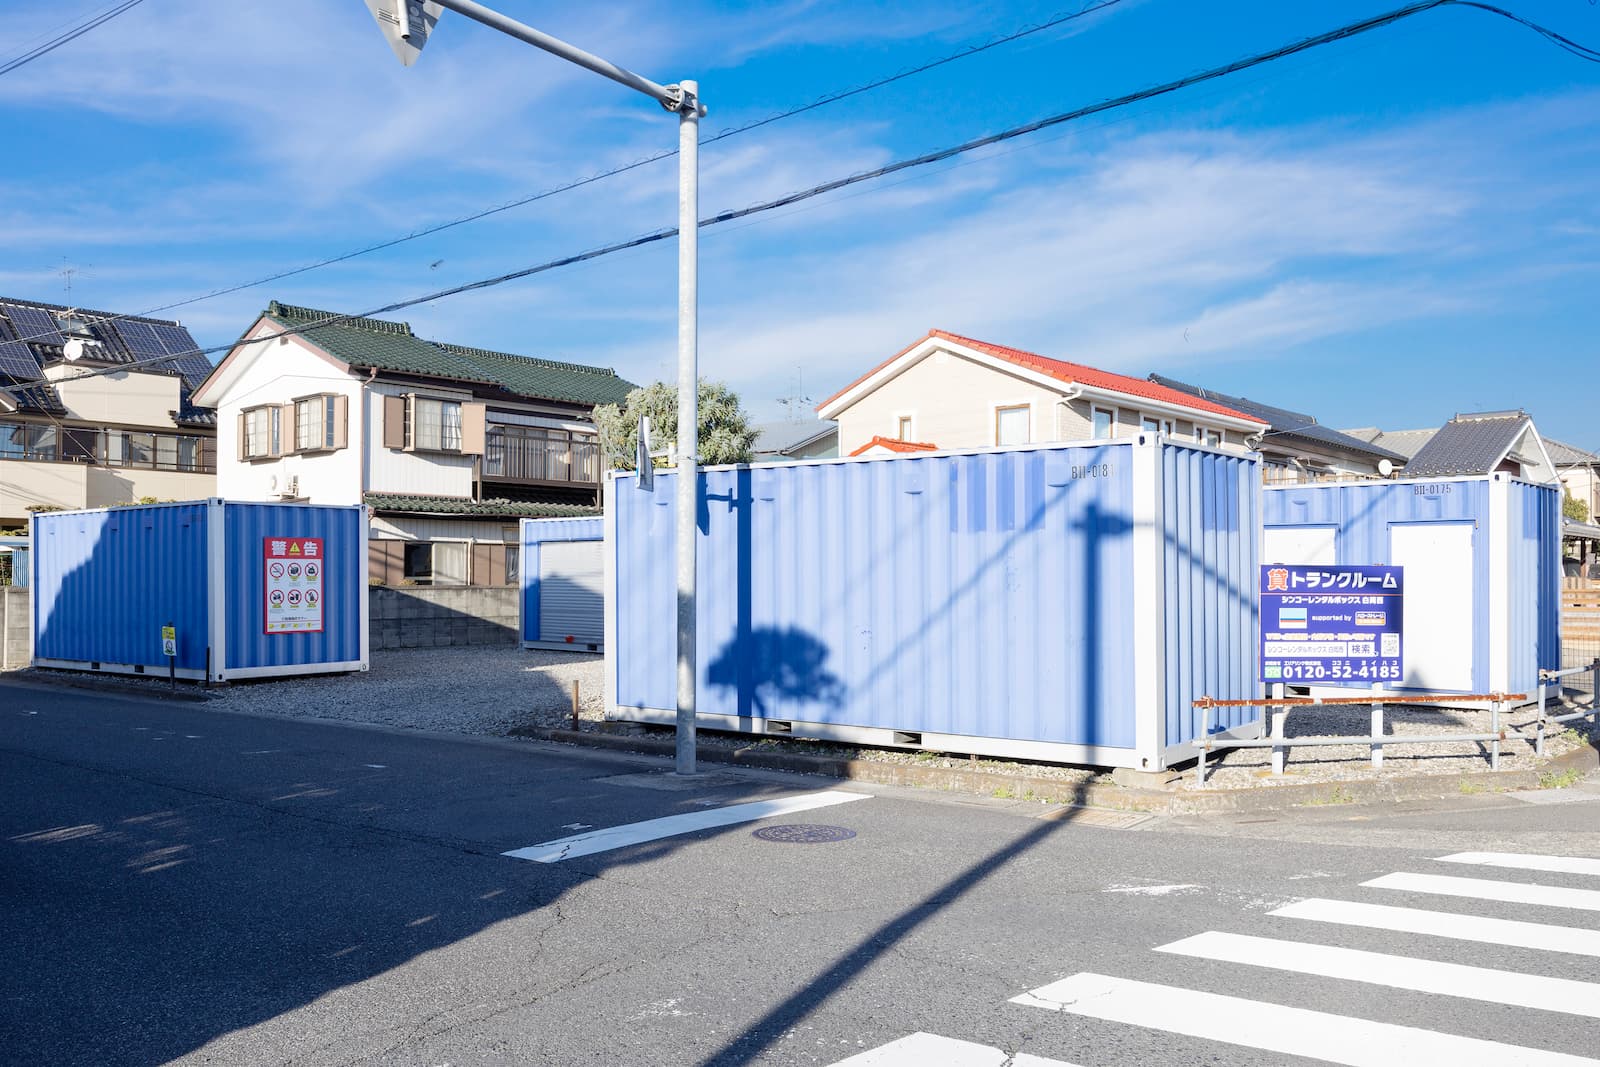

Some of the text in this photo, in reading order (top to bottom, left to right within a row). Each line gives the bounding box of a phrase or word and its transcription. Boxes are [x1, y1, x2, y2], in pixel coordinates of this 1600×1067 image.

[1267, 568, 1398, 591] 貸 トランクルーム
[1351, 643, 1371, 654] 検索
[1283, 666, 1400, 679] 0120-52-4185
